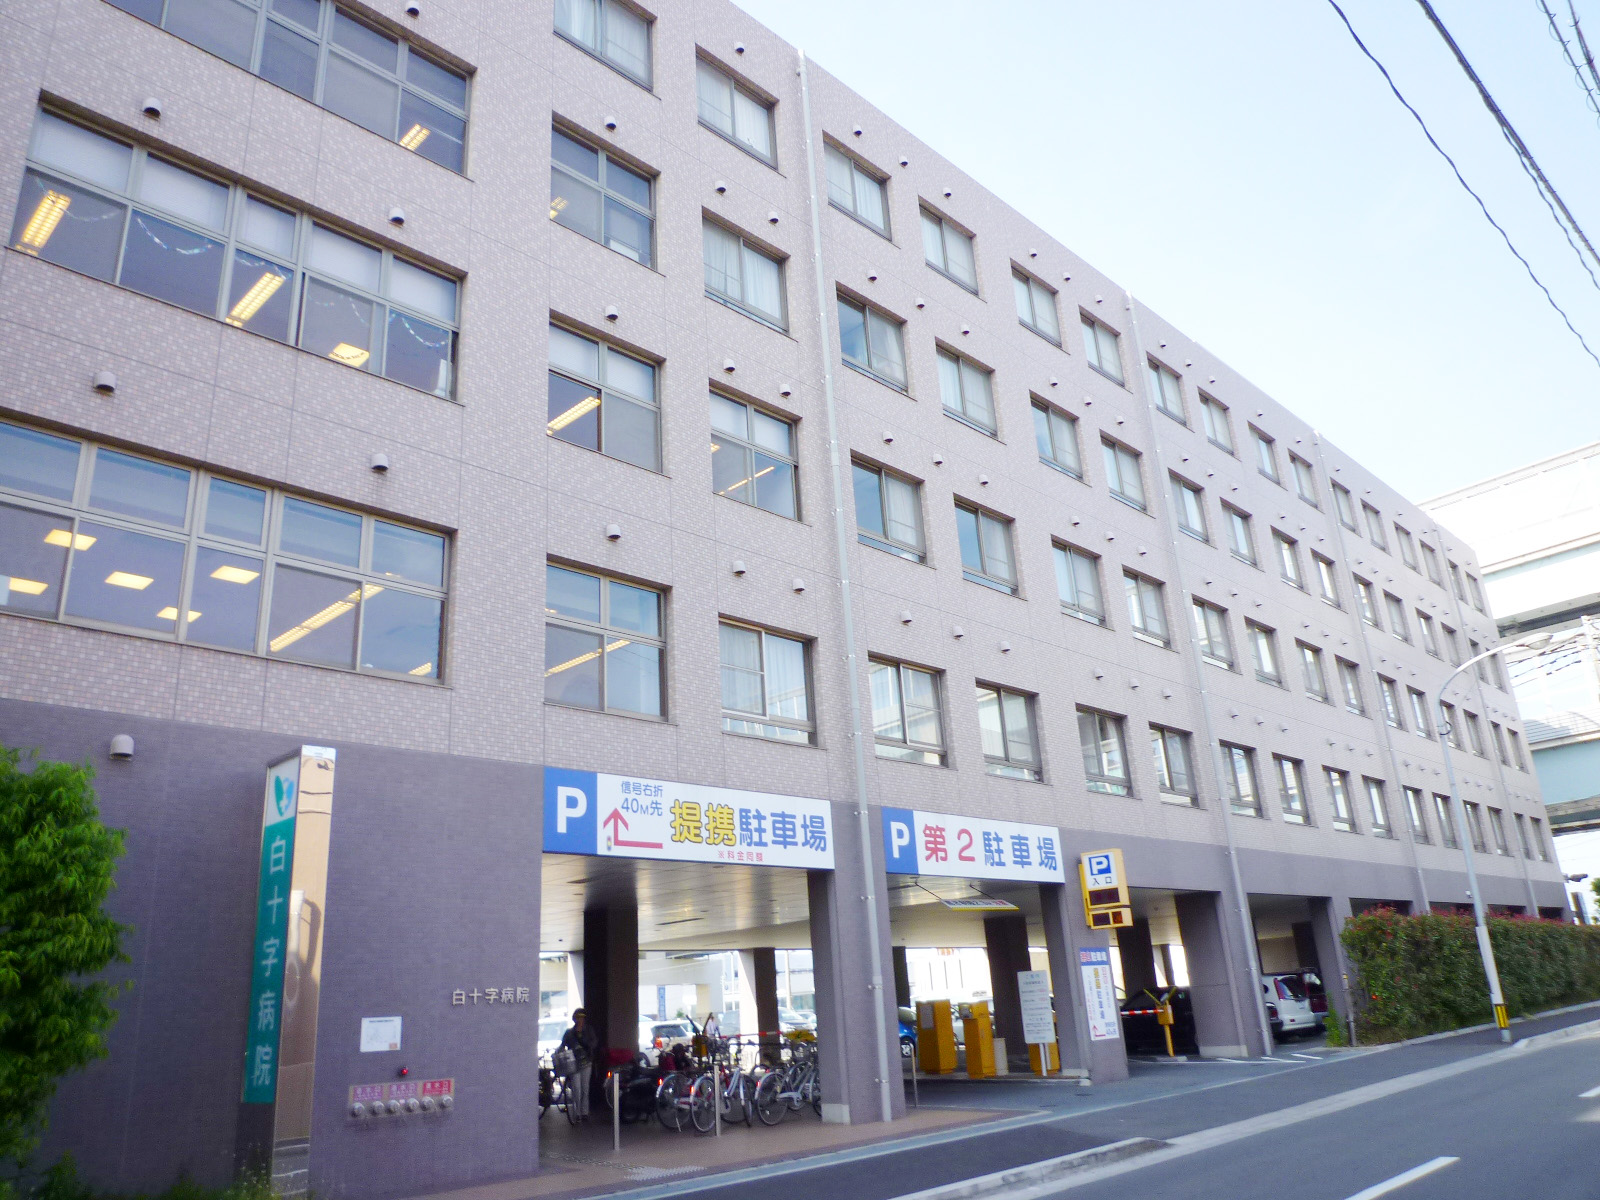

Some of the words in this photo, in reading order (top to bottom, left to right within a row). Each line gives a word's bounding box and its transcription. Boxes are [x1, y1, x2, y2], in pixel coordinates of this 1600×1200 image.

[620, 780, 664, 799] 信号右折
[556, 786, 588, 834] P
[669, 799, 828, 852] 提携駐車場
[890, 820, 911, 859] P
[922, 823, 1058, 871] 第2駐車場
[1091, 856, 1109, 875] P
[1092, 876, 1113, 886] 入口
[251, 836, 287, 1086] 白十字病院
[451, 986, 530, 1006] 白十字病院
